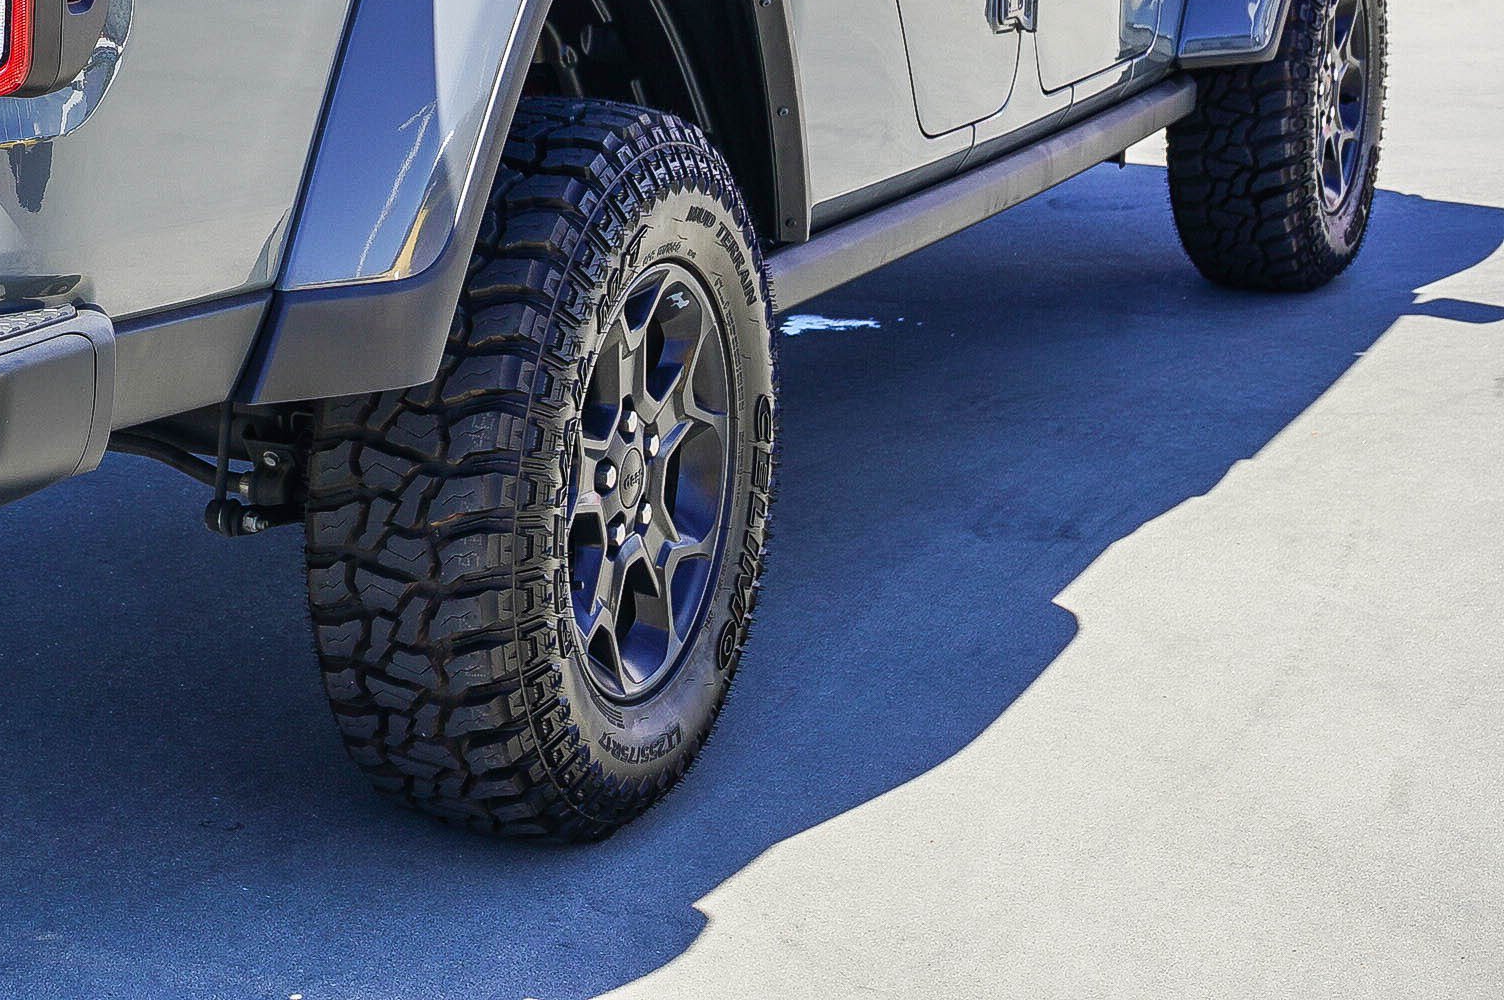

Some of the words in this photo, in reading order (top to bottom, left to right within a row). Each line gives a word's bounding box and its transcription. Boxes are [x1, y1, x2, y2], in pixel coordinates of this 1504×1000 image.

[686, 205, 716, 227] MUD
[714, 221, 757, 306] TERRAIN
[718, 393, 773, 671] CELIMO
